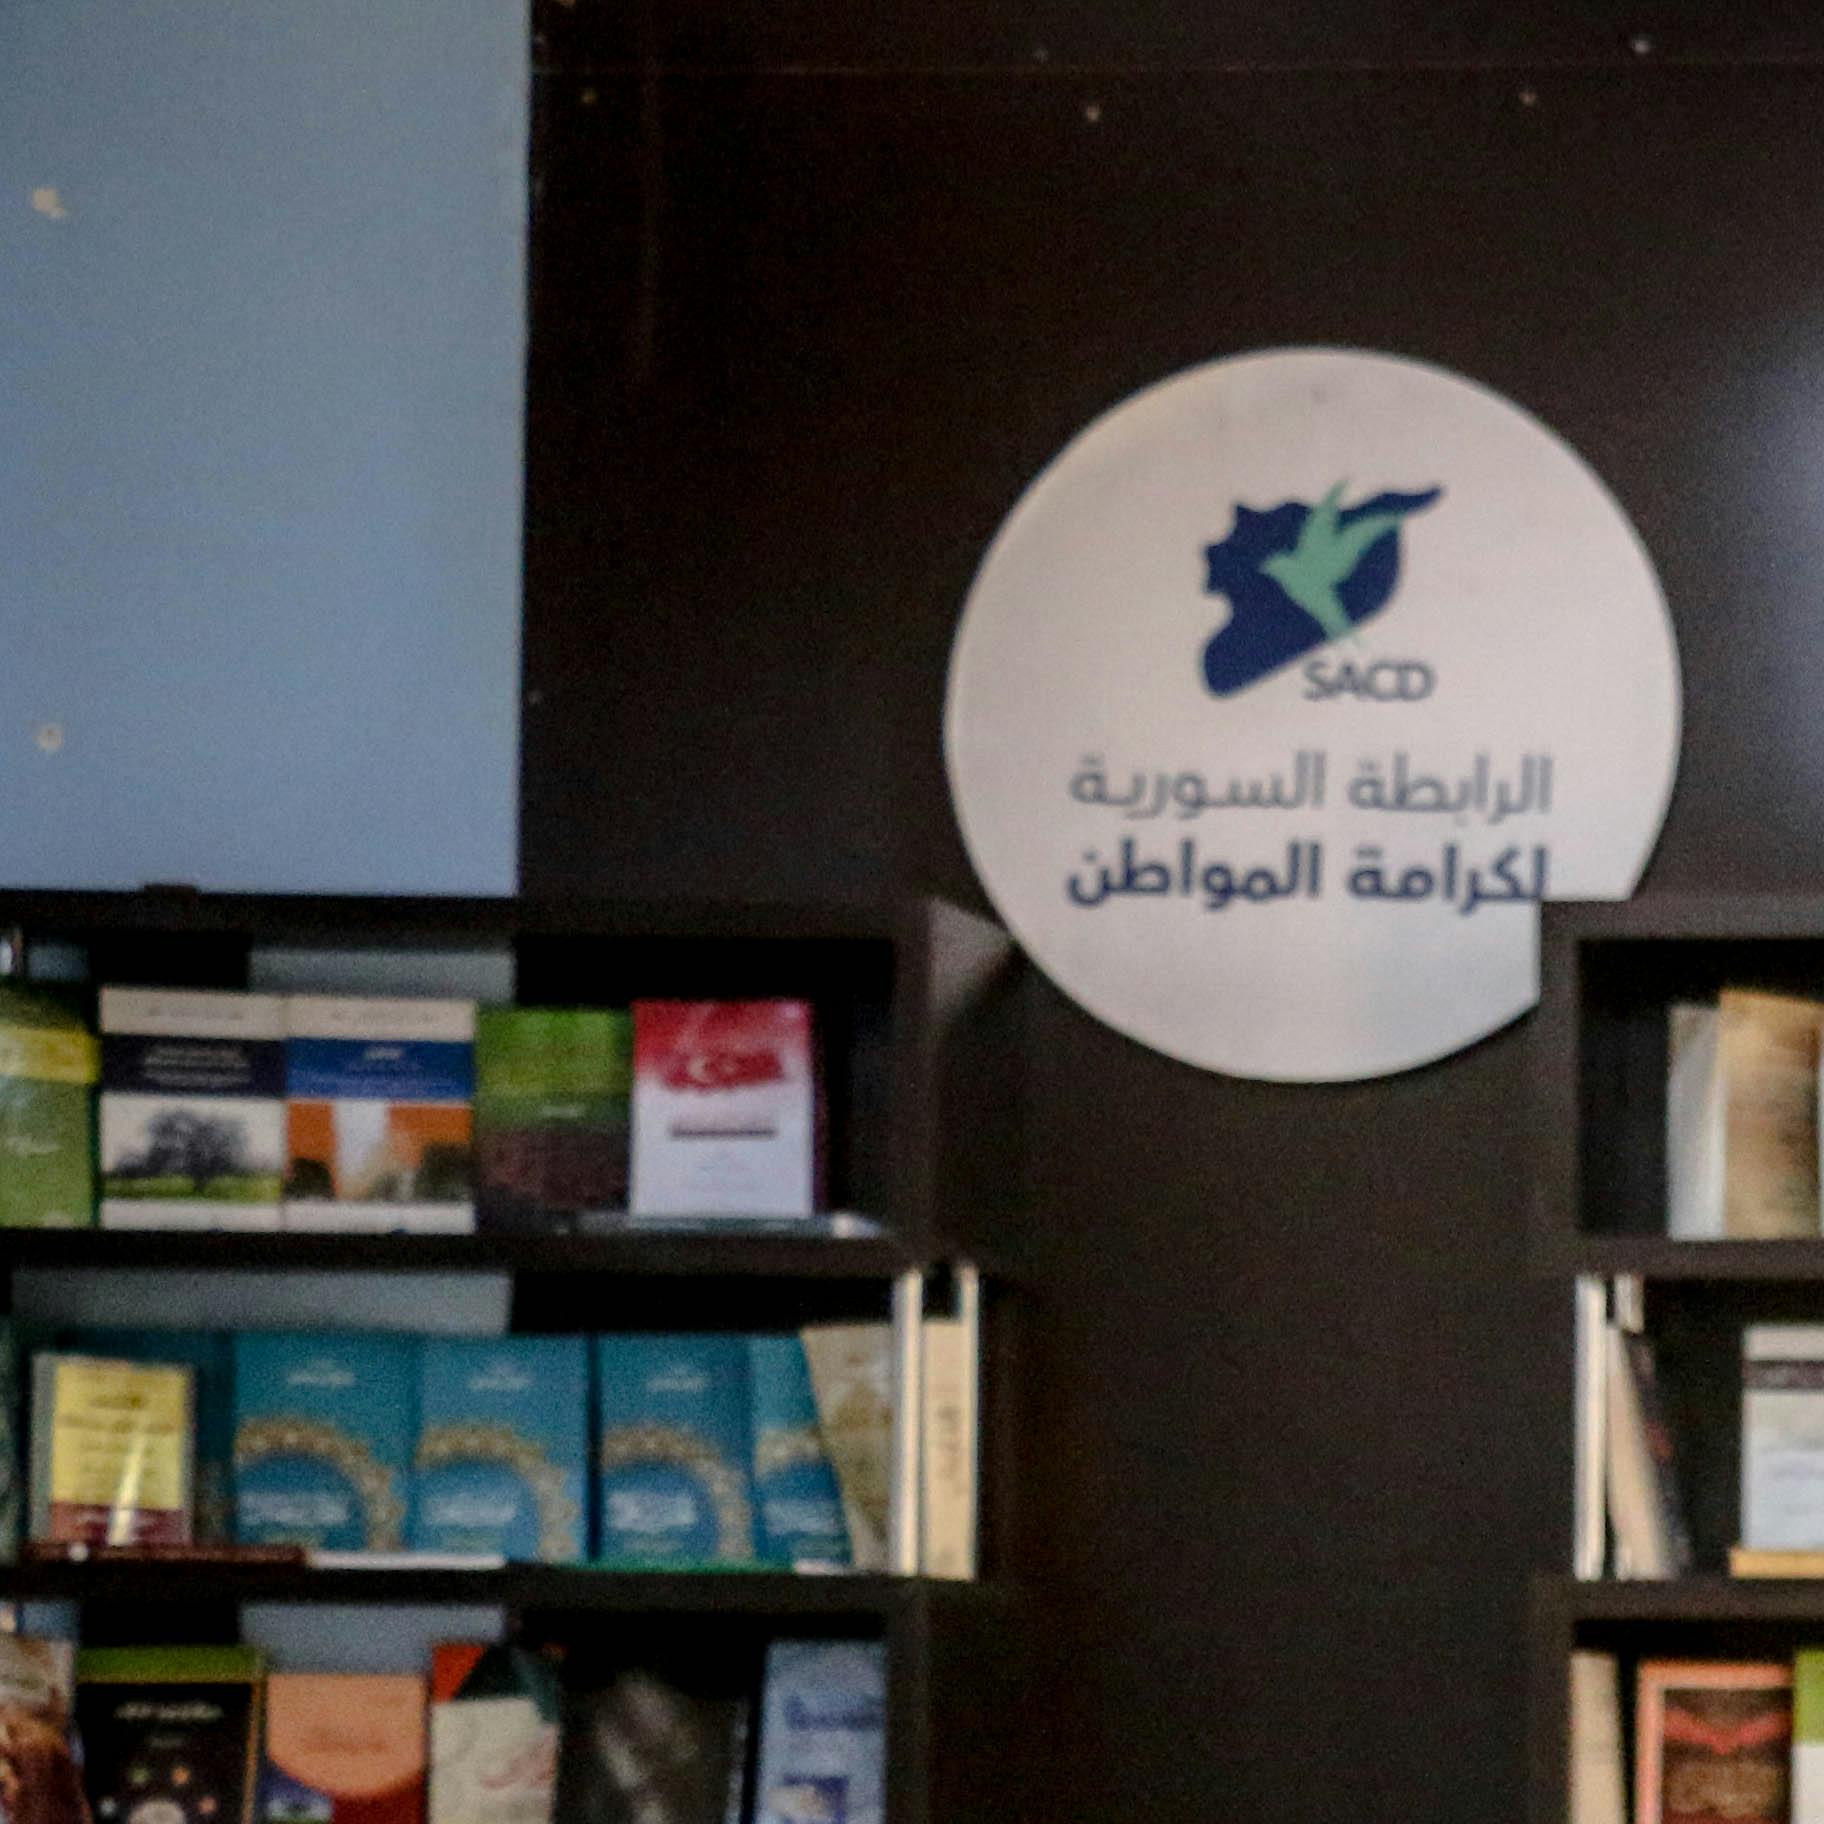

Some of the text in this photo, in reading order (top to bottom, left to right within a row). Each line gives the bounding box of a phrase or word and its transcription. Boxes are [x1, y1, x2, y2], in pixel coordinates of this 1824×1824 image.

[1303, 657, 1437, 702] SACD
[1069, 751, 1554, 825] الرابطة السورية
[1066, 836, 1553, 917] لكرامة المواطن
